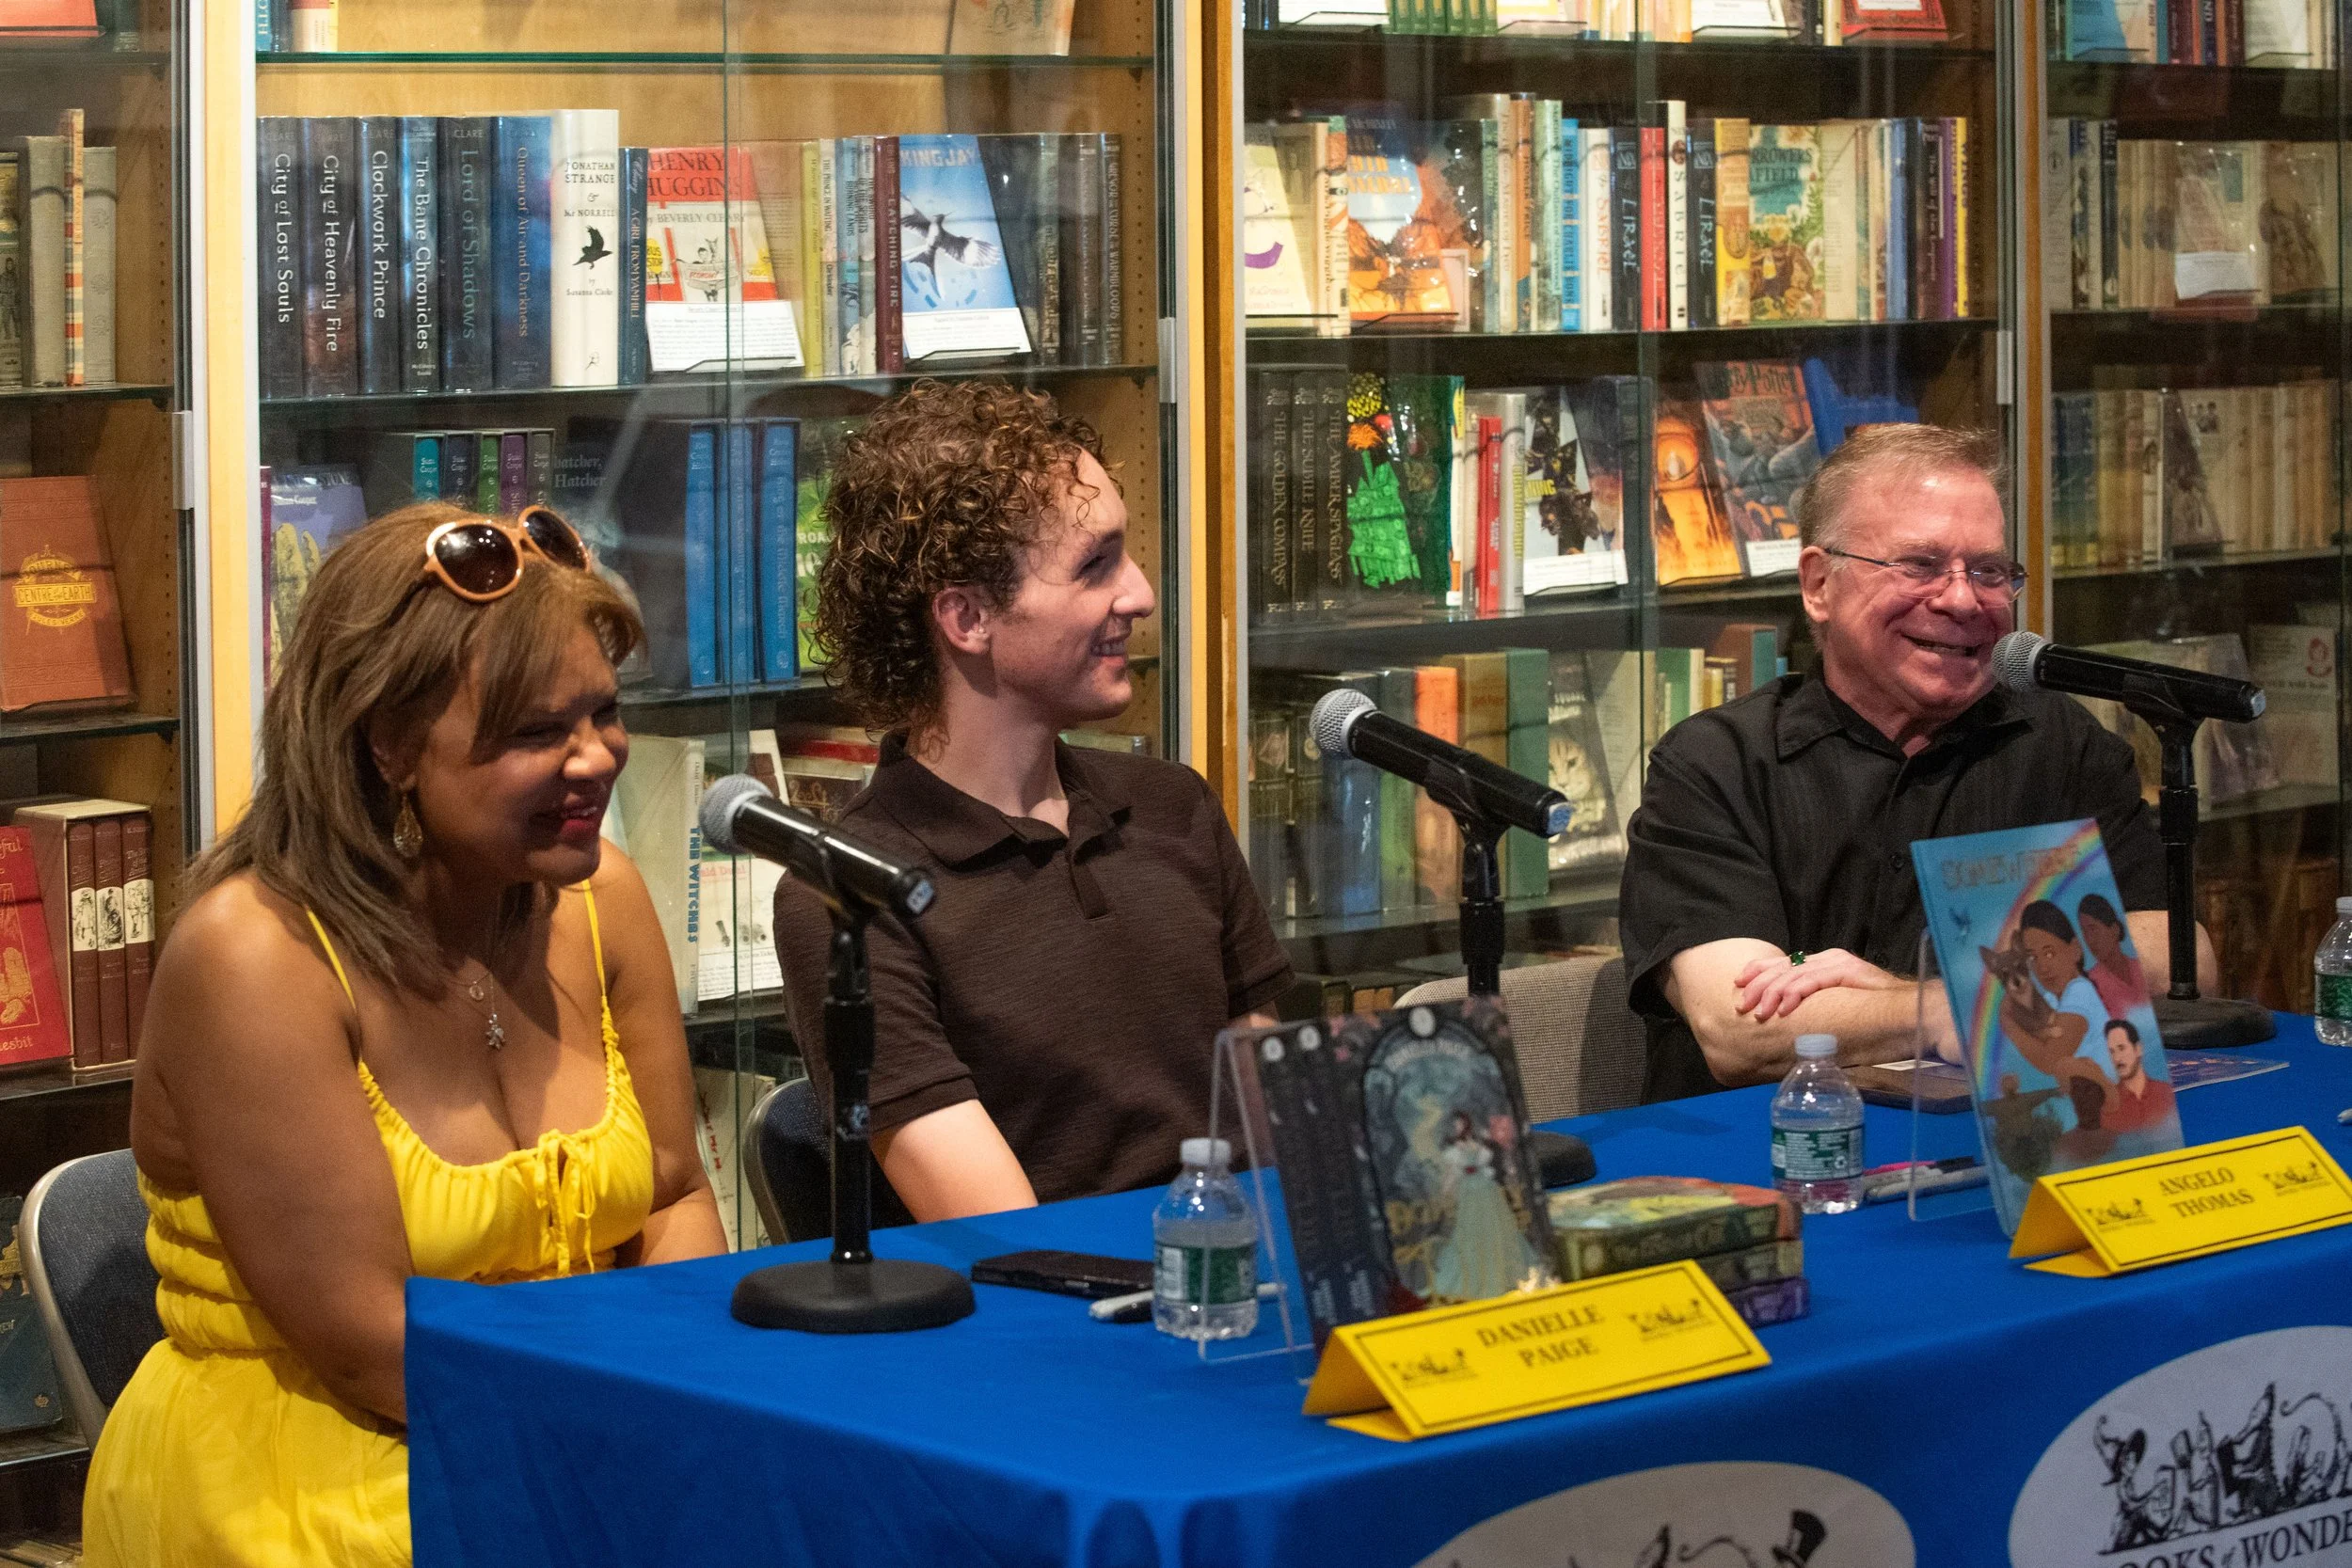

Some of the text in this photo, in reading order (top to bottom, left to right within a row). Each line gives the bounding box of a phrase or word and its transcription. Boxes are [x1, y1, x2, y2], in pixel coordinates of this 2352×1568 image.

[320, 155, 340, 195] City
[415, 156, 430, 187] The
[564, 161, 615, 172] JONATHAN
[650, 151, 724, 172] HENRY
[899, 148, 977, 167] KINGJAY
[564, 173, 615, 184] STRANGE
[323, 199, 339, 214] of
[415, 193, 431, 241] Bane
[659, 213, 702, 223] BEVERLY
[824, 204, 833, 232] WAITING
[858, 204, 868, 234] SPIRITS
[270, 153, 294, 323] City of Lost Souls
[372, 150, 390, 319] Clockwork Prince
[460, 150, 483, 340] Lord of Shadows
[517, 146, 532, 337] Queen of Air and Darkness
[888, 198, 898, 269] CATCHING
[1622, 198, 1637, 275] LIRAEL
[1674, 170, 1686, 291] SABRIEL
[1699, 197, 1716, 275] LIRAEL
[321, 221, 342, 309] Heavenly
[415, 246, 433, 350] Chronicles
[326, 317, 342, 352] Fire
[553, 453, 602, 469] hatcher,
[1271, 411, 1288, 590] THE GOLDEN COMPASS
[1300, 410, 1316, 553] THE SUBTLE KNIFE
[1327, 409, 1344, 585] THE AMBER SPYGLASS
[19, 585, 91, 603] CENTRE EARTH
[687, 827, 702, 944] THE WITCHES
[0, 1035, 33, 1052] esbit
[2159, 1166, 2235, 1196] ANGELO
[2169, 1188, 2256, 1219] THOMAS
[1475, 1304, 1605, 1349] DANIELLE
[1518, 1336, 1599, 1370] PAIGE
